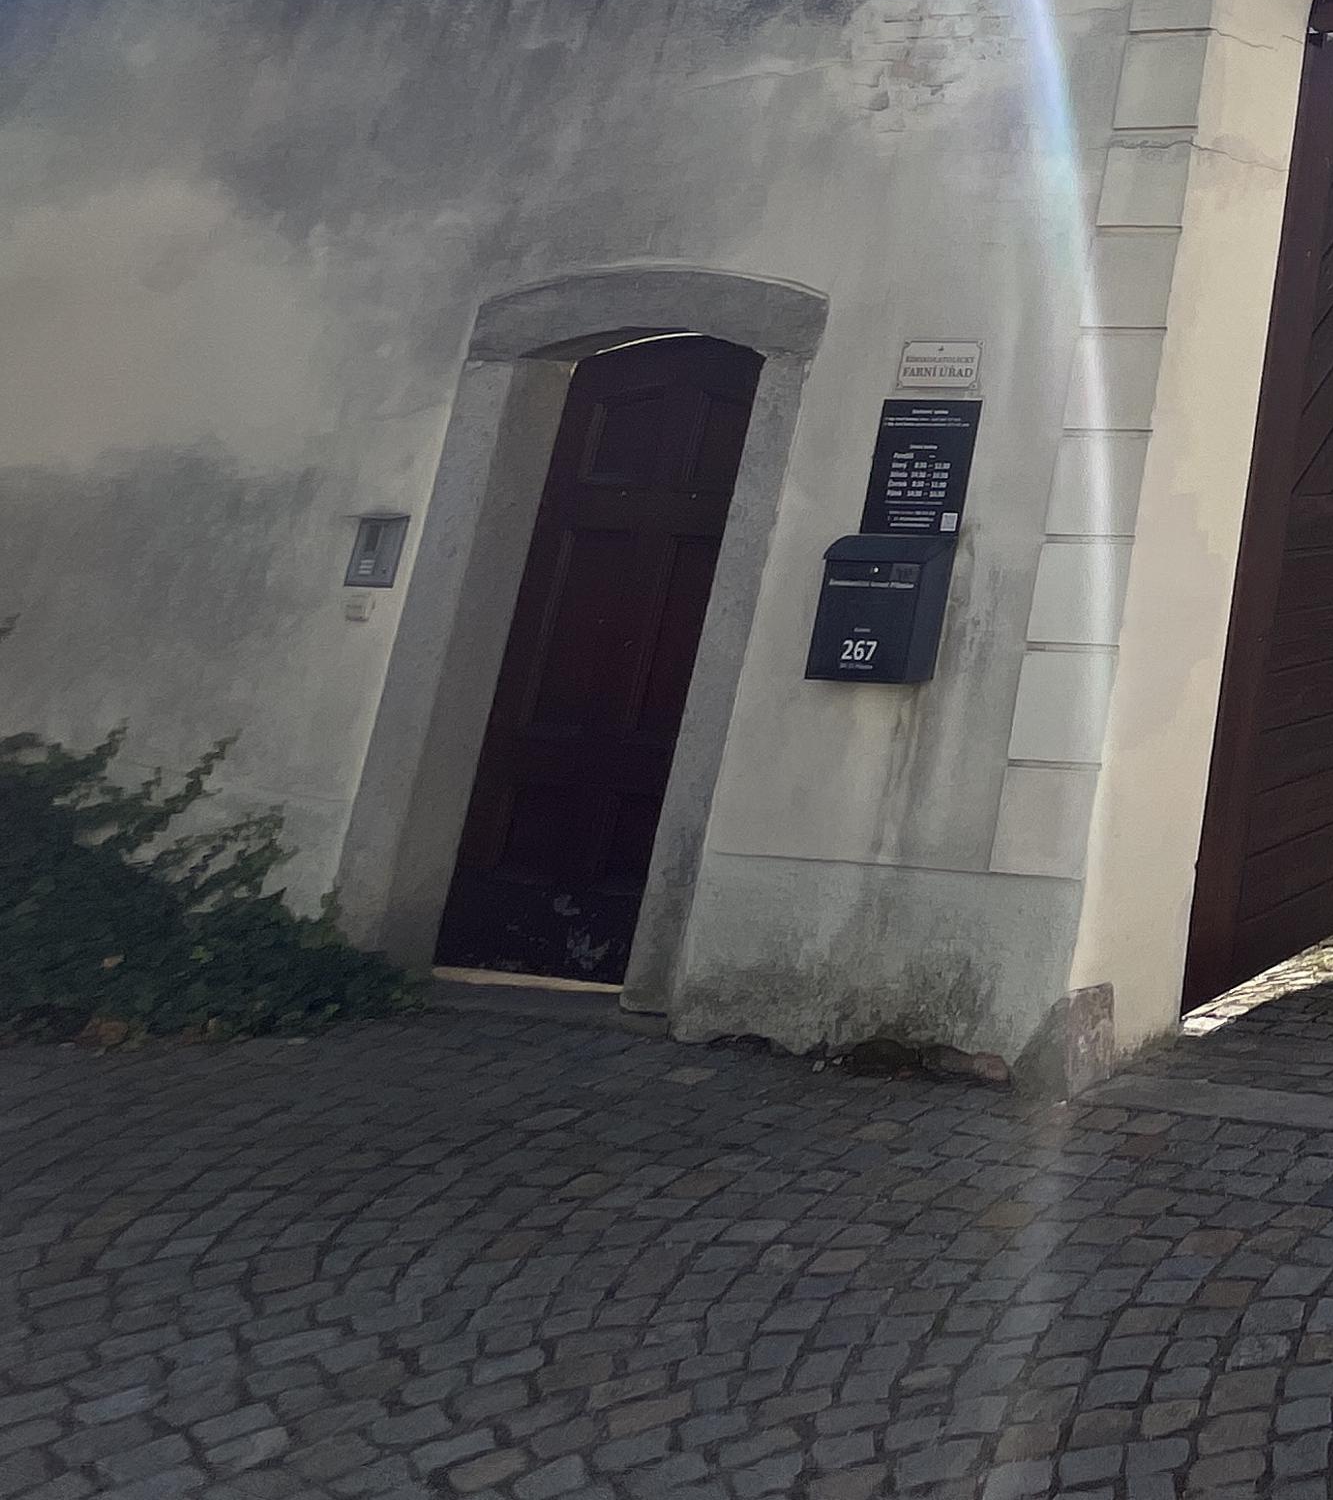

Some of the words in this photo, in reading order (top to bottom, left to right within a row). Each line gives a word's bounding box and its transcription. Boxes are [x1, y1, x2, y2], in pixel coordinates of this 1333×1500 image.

[902, 365, 938, 378] FARNÍ
[939, 365, 974, 378] ÚŘAD
[841, 639, 878, 661] 267
